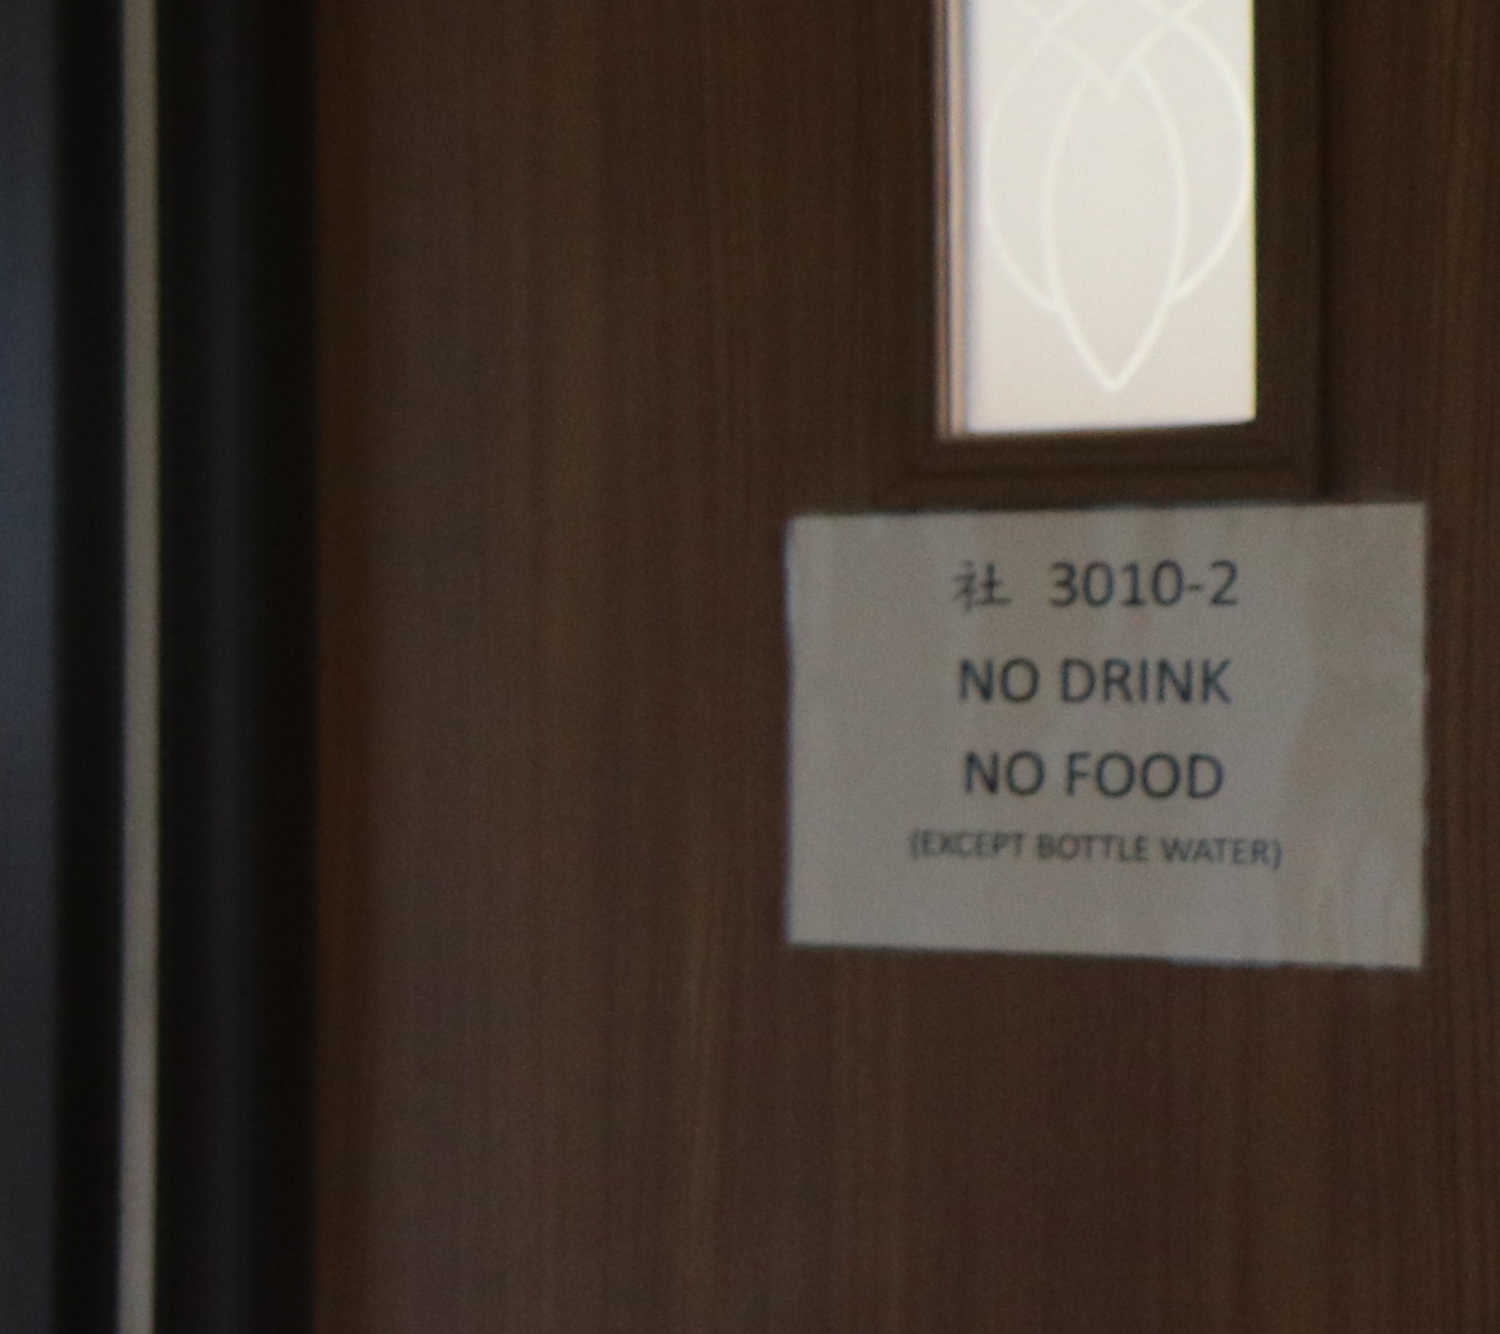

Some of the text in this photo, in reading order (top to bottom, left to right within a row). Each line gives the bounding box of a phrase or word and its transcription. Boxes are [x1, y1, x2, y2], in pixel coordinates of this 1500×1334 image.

[954, 558, 1238, 611] 社 3010-2
[958, 657, 1231, 705] NO DRINK
[964, 750, 1224, 801] NO FOOD
[909, 829, 1282, 870] (EXCEPT BOTTLE WATER)
